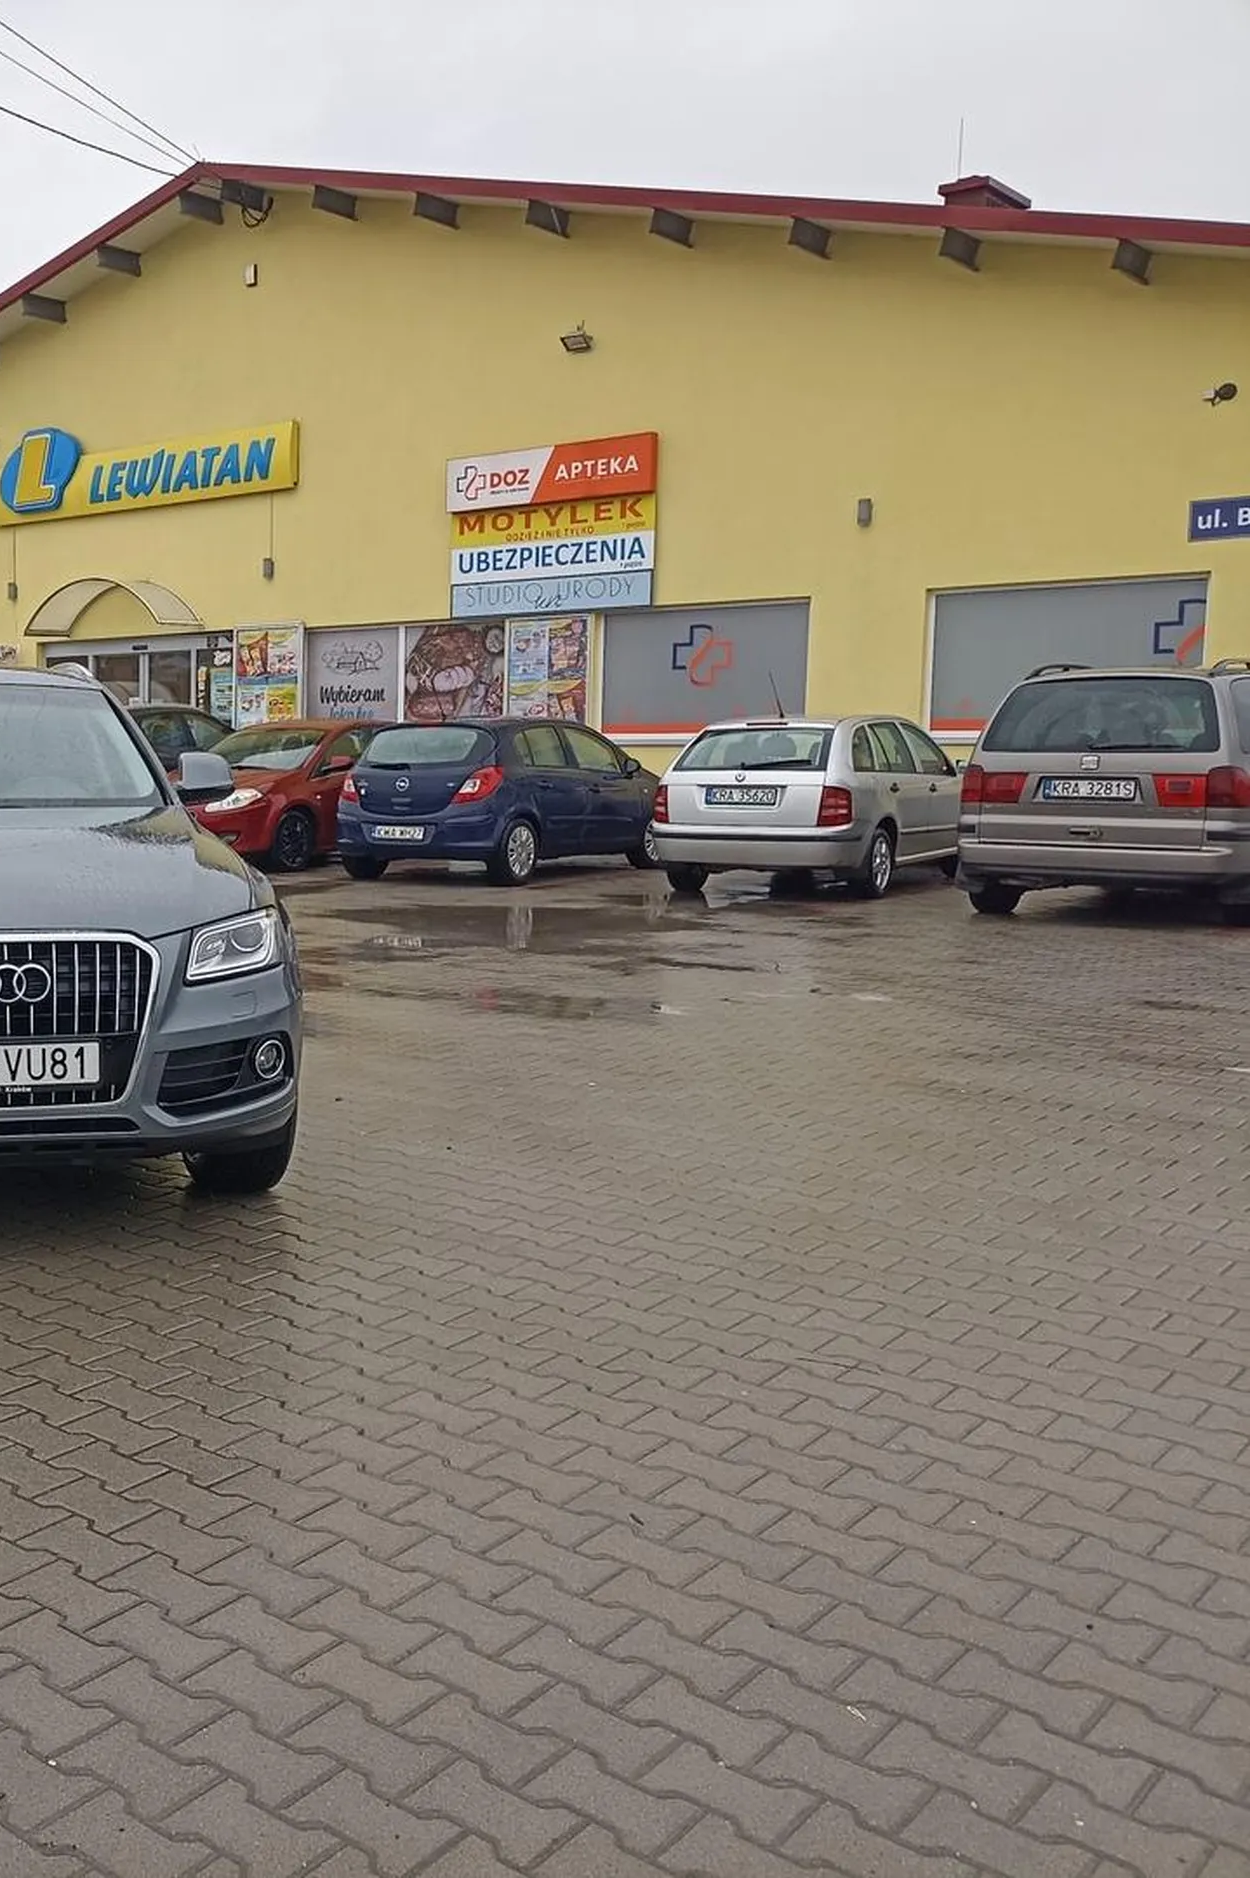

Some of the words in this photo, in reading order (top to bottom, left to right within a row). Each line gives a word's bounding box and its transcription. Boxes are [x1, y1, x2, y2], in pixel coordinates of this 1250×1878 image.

[88, 438, 276, 504] LEWIATAN
[489, 468, 530, 489] DOZ
[555, 454, 639, 481] APTEKA
[458, 498, 644, 536] MOTYLEK
[1197, 508, 1228, 529] ul.
[458, 537, 646, 574] UBEZPIECZENIA
[465, 583, 544, 608] STUDIO
[556, 577, 636, 601] URODY
[320, 685, 386, 706] Wybieram
[712, 789, 734, 801] KRA
[1053, 781, 1079, 795] KRA
[4, 1046, 86, 1082] VU81
